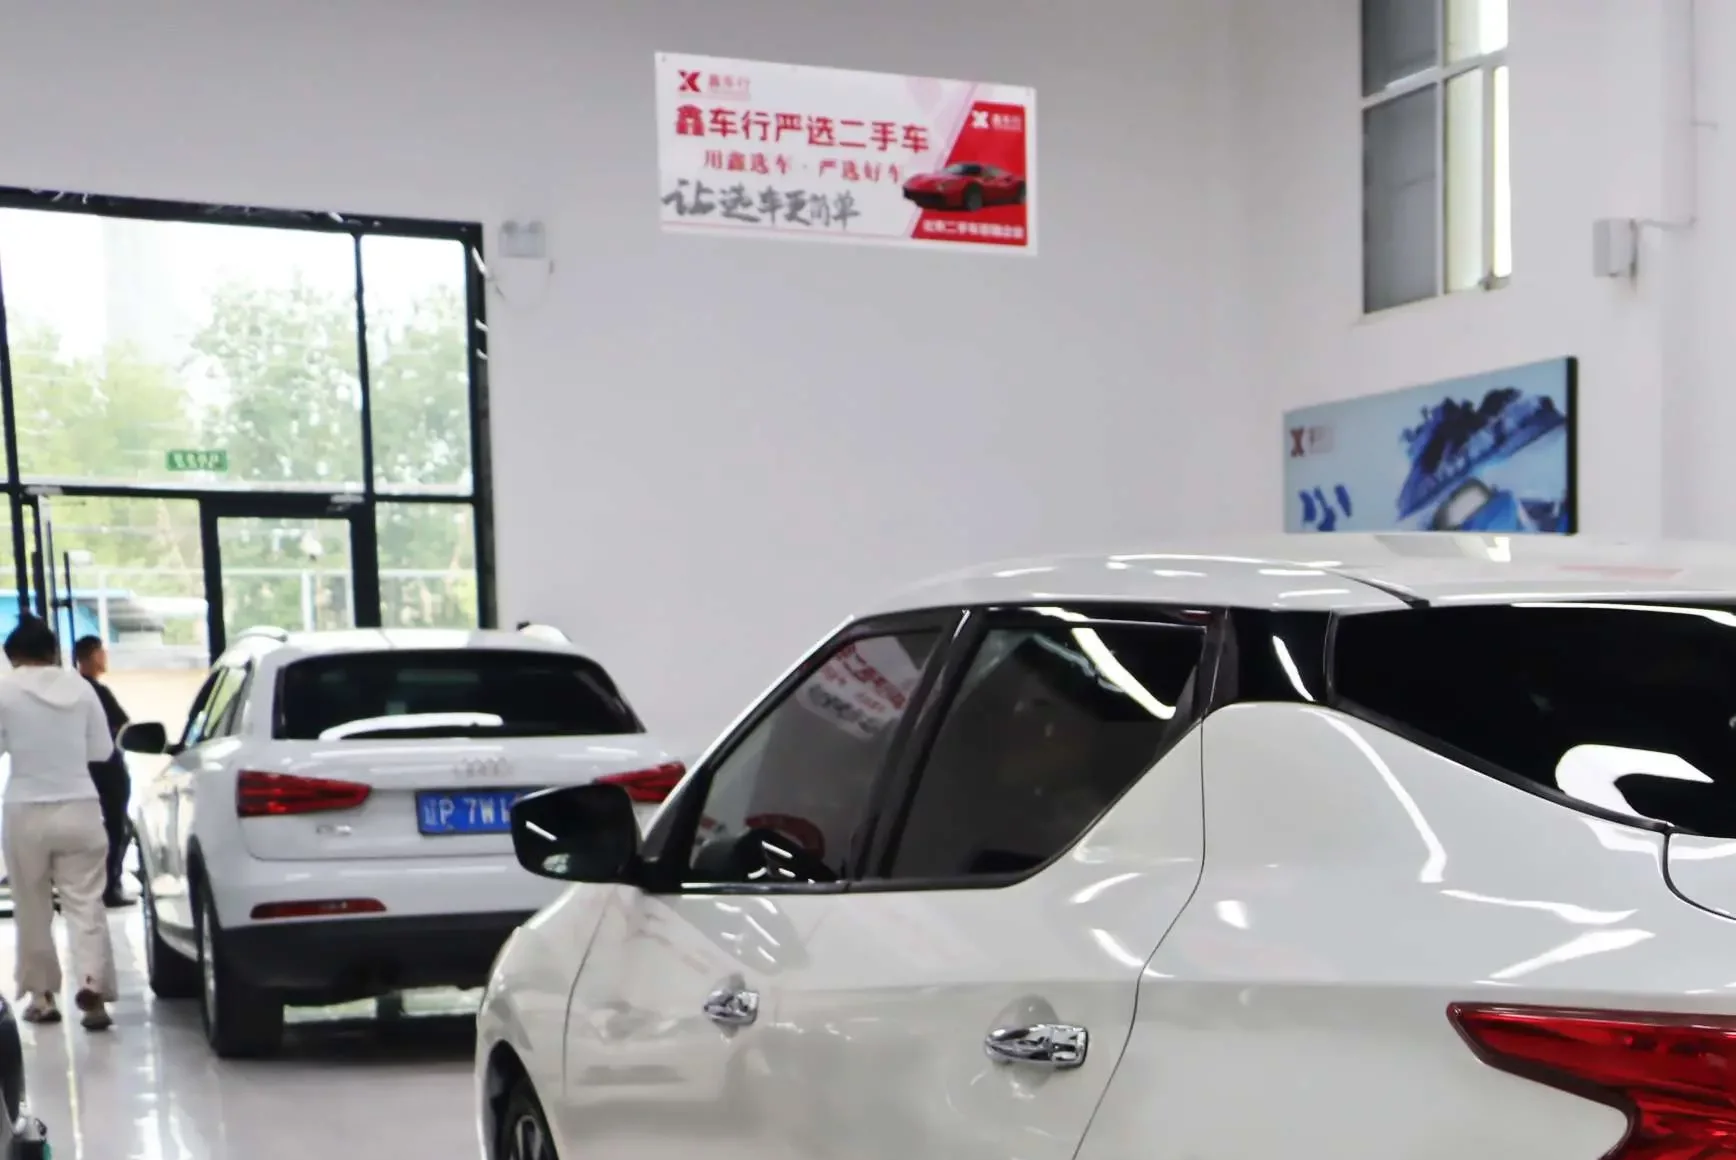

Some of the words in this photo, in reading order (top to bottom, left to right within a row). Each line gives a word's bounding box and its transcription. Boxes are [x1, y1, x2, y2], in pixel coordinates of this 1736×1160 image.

[676, 103, 930, 153] 鑫车行严选二手车
[661, 177, 861, 230] 让选车更简单
